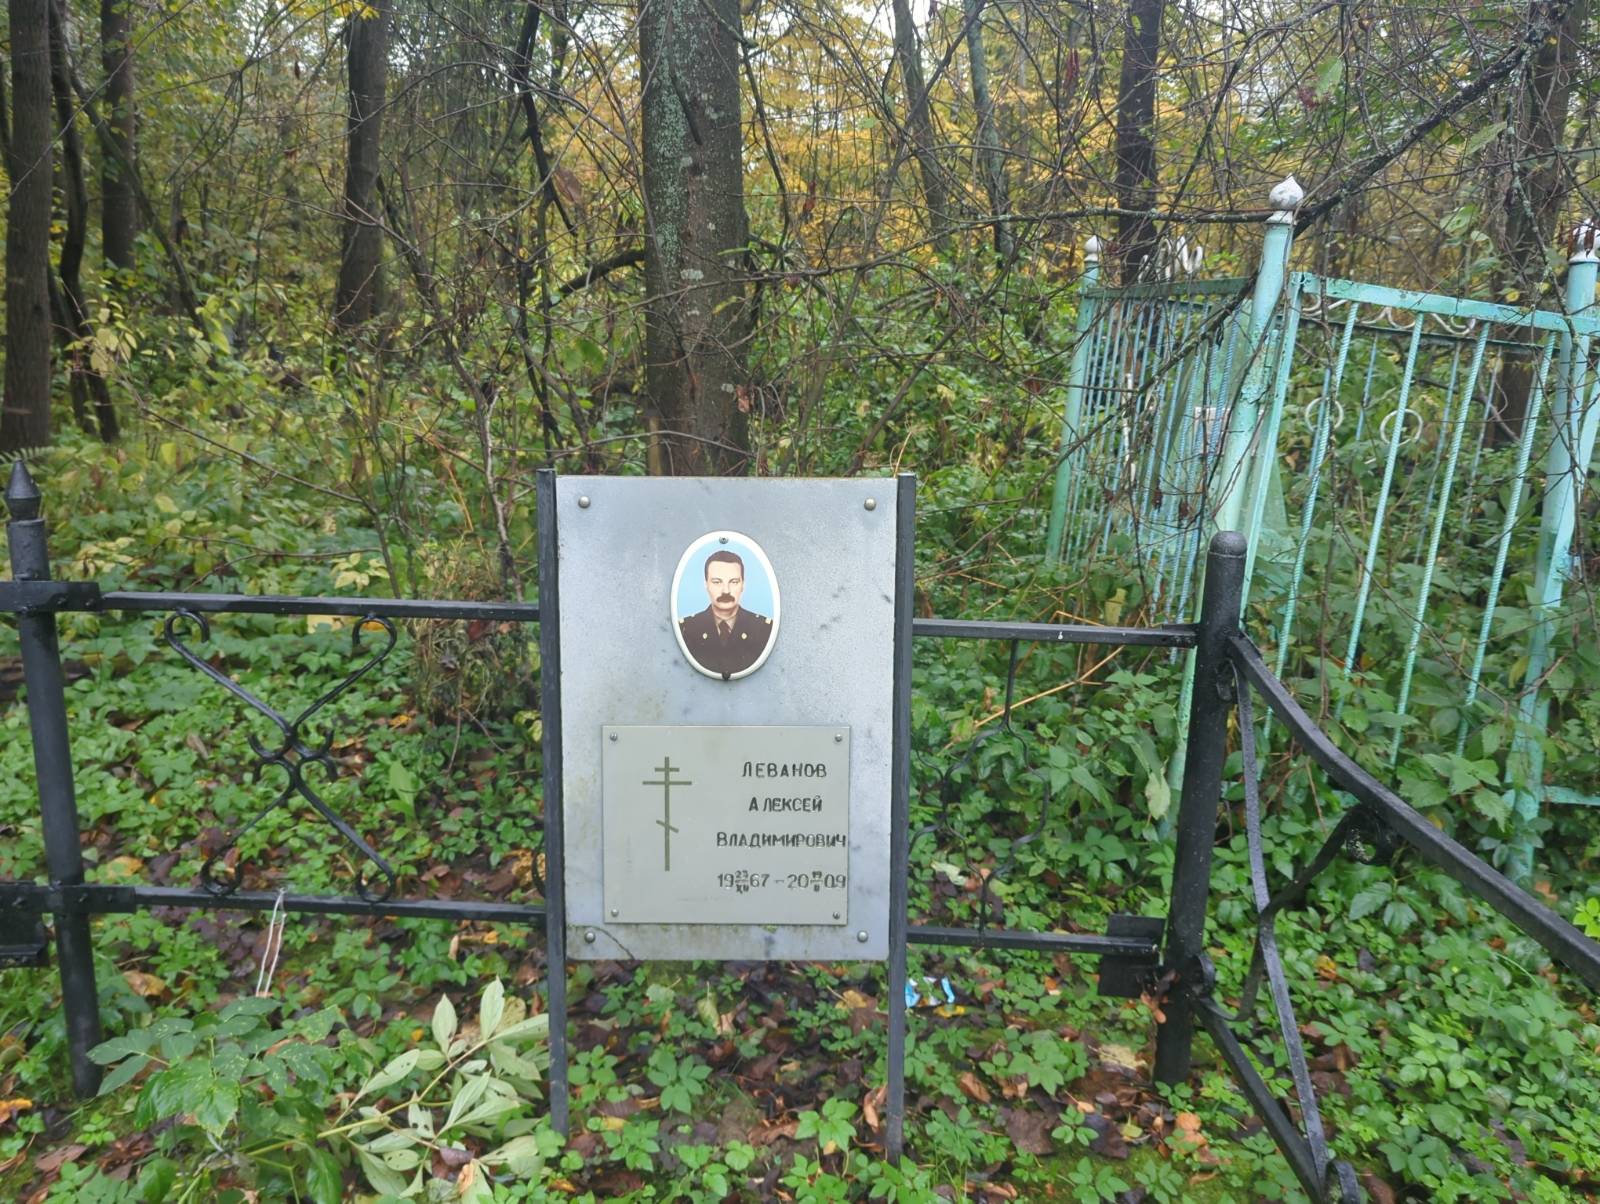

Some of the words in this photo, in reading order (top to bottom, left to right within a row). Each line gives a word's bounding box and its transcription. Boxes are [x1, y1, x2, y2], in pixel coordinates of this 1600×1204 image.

[742, 761, 827, 778] ЛЕВАНОВ
[748, 795, 823, 812] АЛЕКСЕЙ
[716, 831, 847, 848] ВЛАДИМИРОВИЧ
